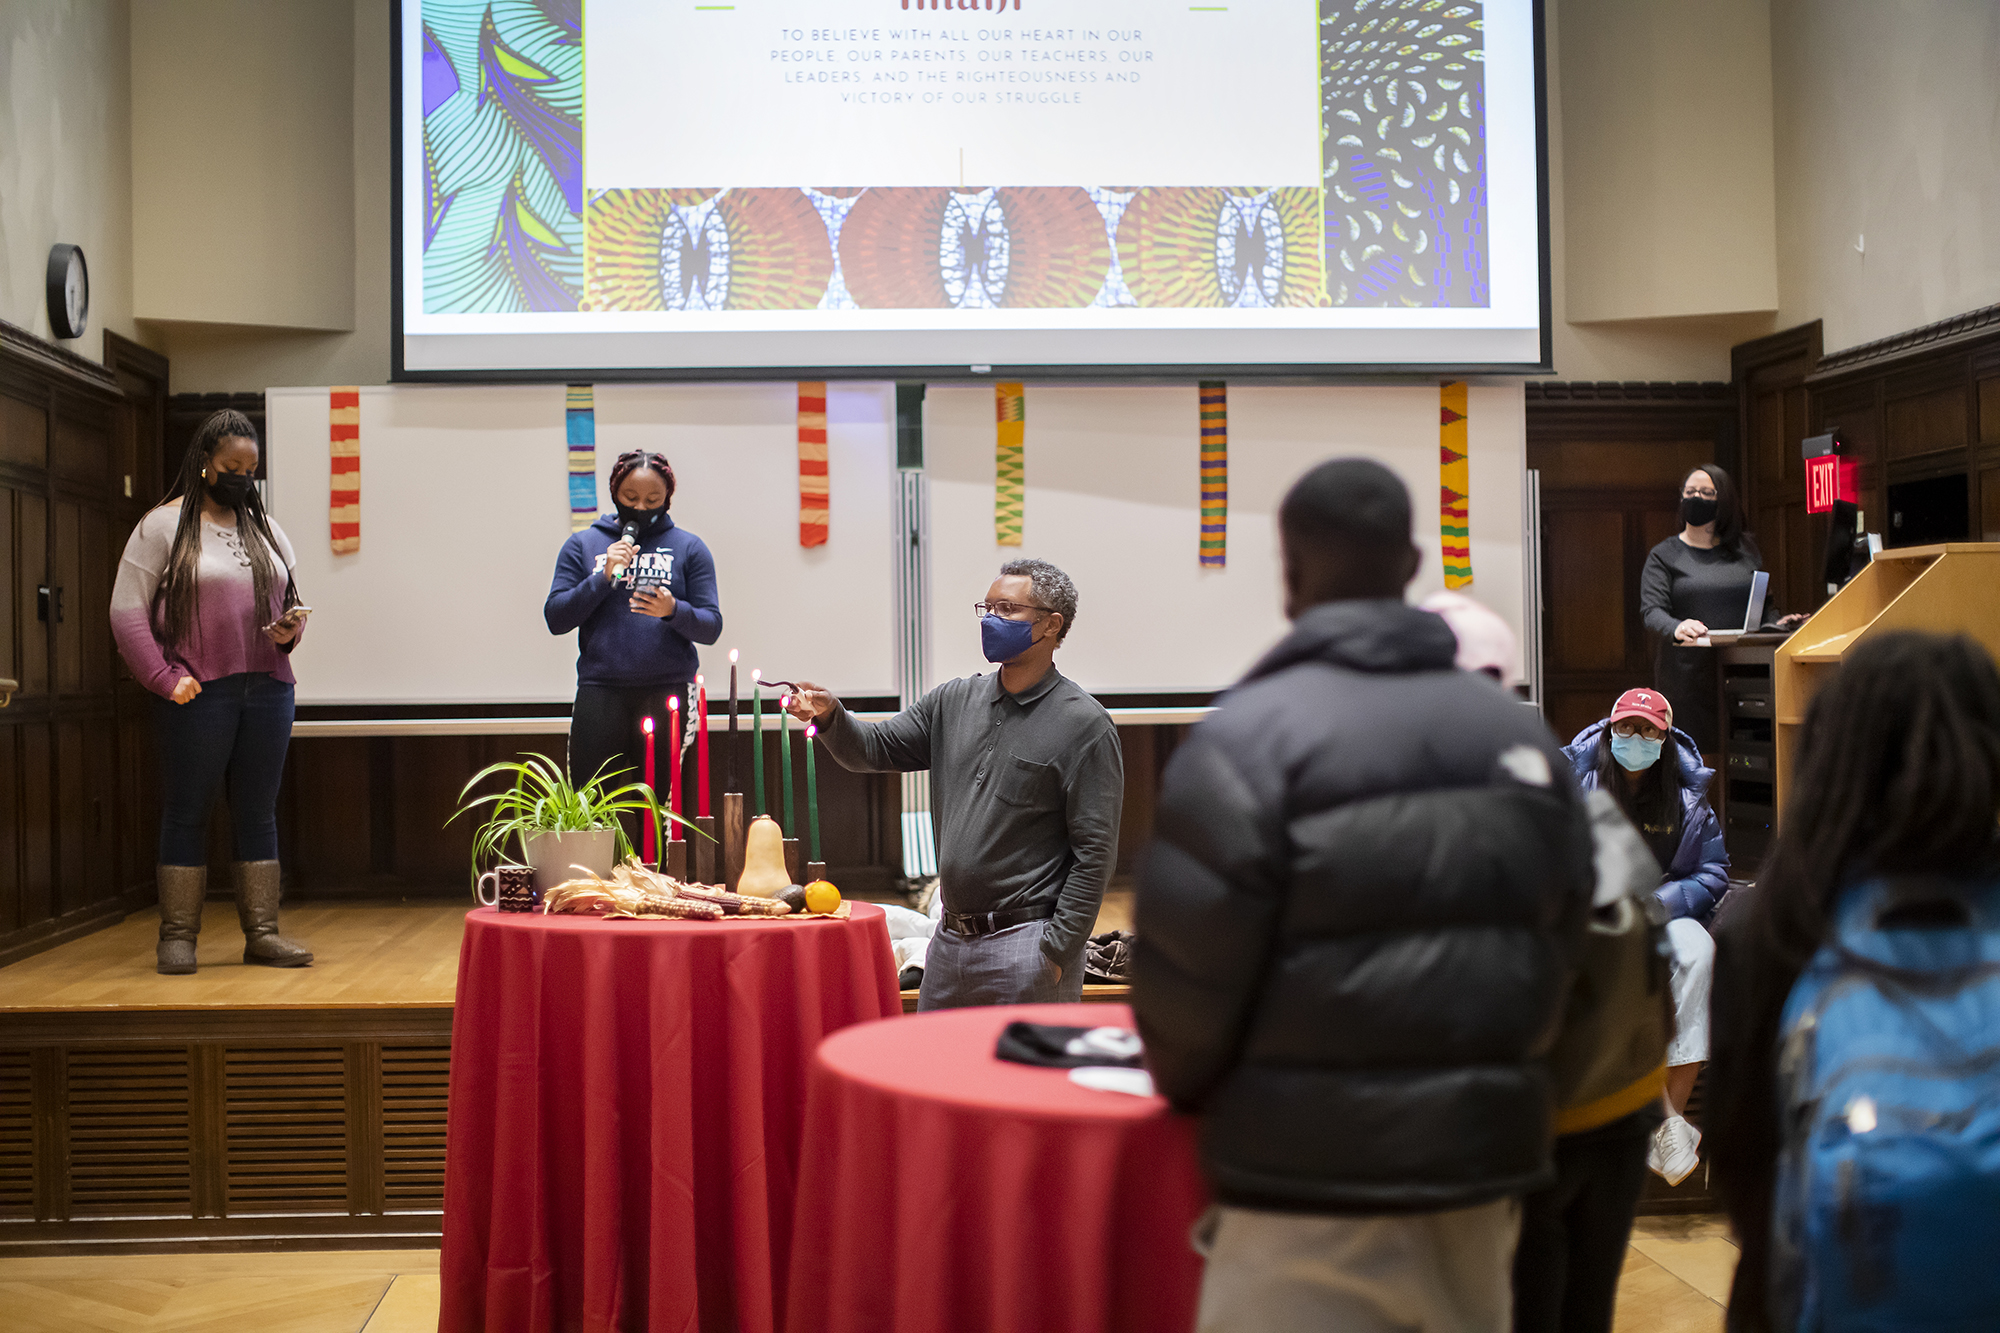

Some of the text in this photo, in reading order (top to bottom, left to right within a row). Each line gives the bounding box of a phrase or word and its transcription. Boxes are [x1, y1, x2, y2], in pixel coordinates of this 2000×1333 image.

[781, 29, 1143, 41] TO BELIEVE WITH ALL OUR HEART IN OUR
[846, 49, 883, 62] OUR
[977, 49, 1013, 62] OUR
[1118, 49, 1154, 62] OUR
[872, 70, 910, 83] AND
[917, 70, 948, 83] THE
[955, 70, 1098, 83] RIGHTEOUSNESS
[1104, 70, 1141, 83] AND
[840, 91, 1082, 104] VICTORY OF OUR STRUGGLE
[1812, 462, 1834, 507] EXIT
[592, 553, 674, 573] PNN
